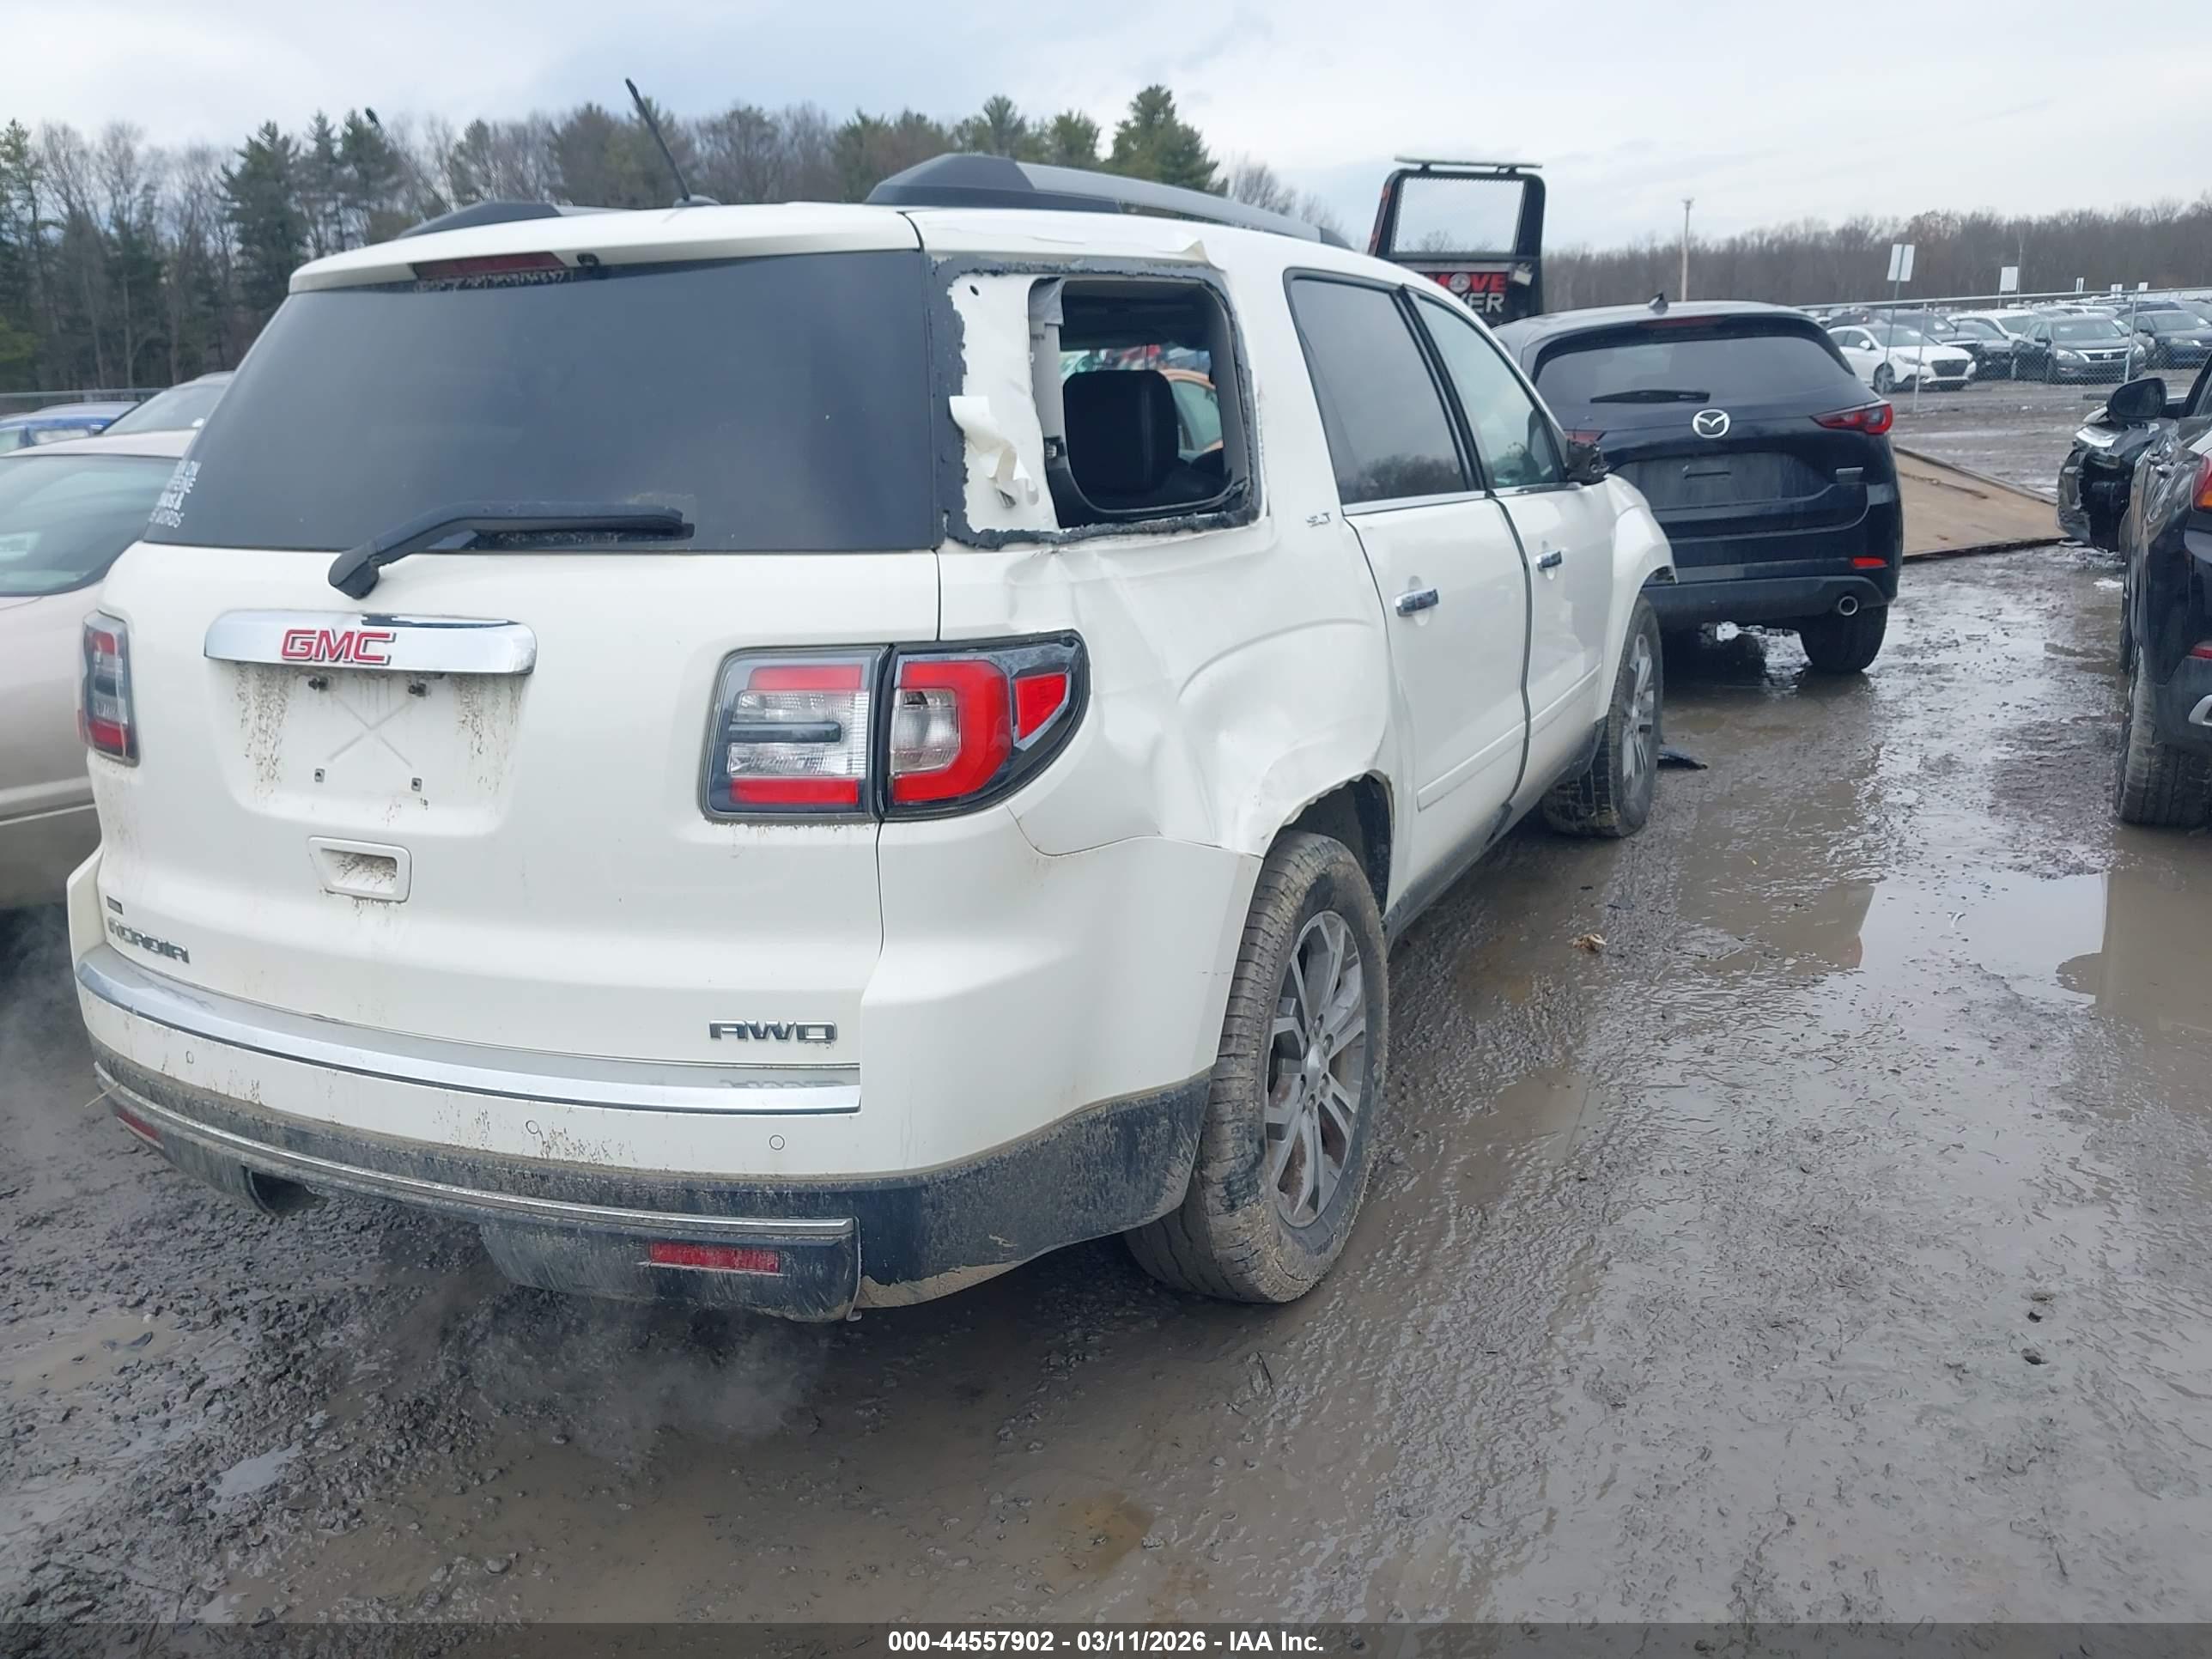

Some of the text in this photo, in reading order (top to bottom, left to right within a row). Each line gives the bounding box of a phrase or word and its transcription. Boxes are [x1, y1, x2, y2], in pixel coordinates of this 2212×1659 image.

[1305, 513, 1331, 526] SLT
[282, 629, 396, 665] GMC
[108, 917, 190, 963] ACADIA
[709, 1020, 838, 1042] AWD
